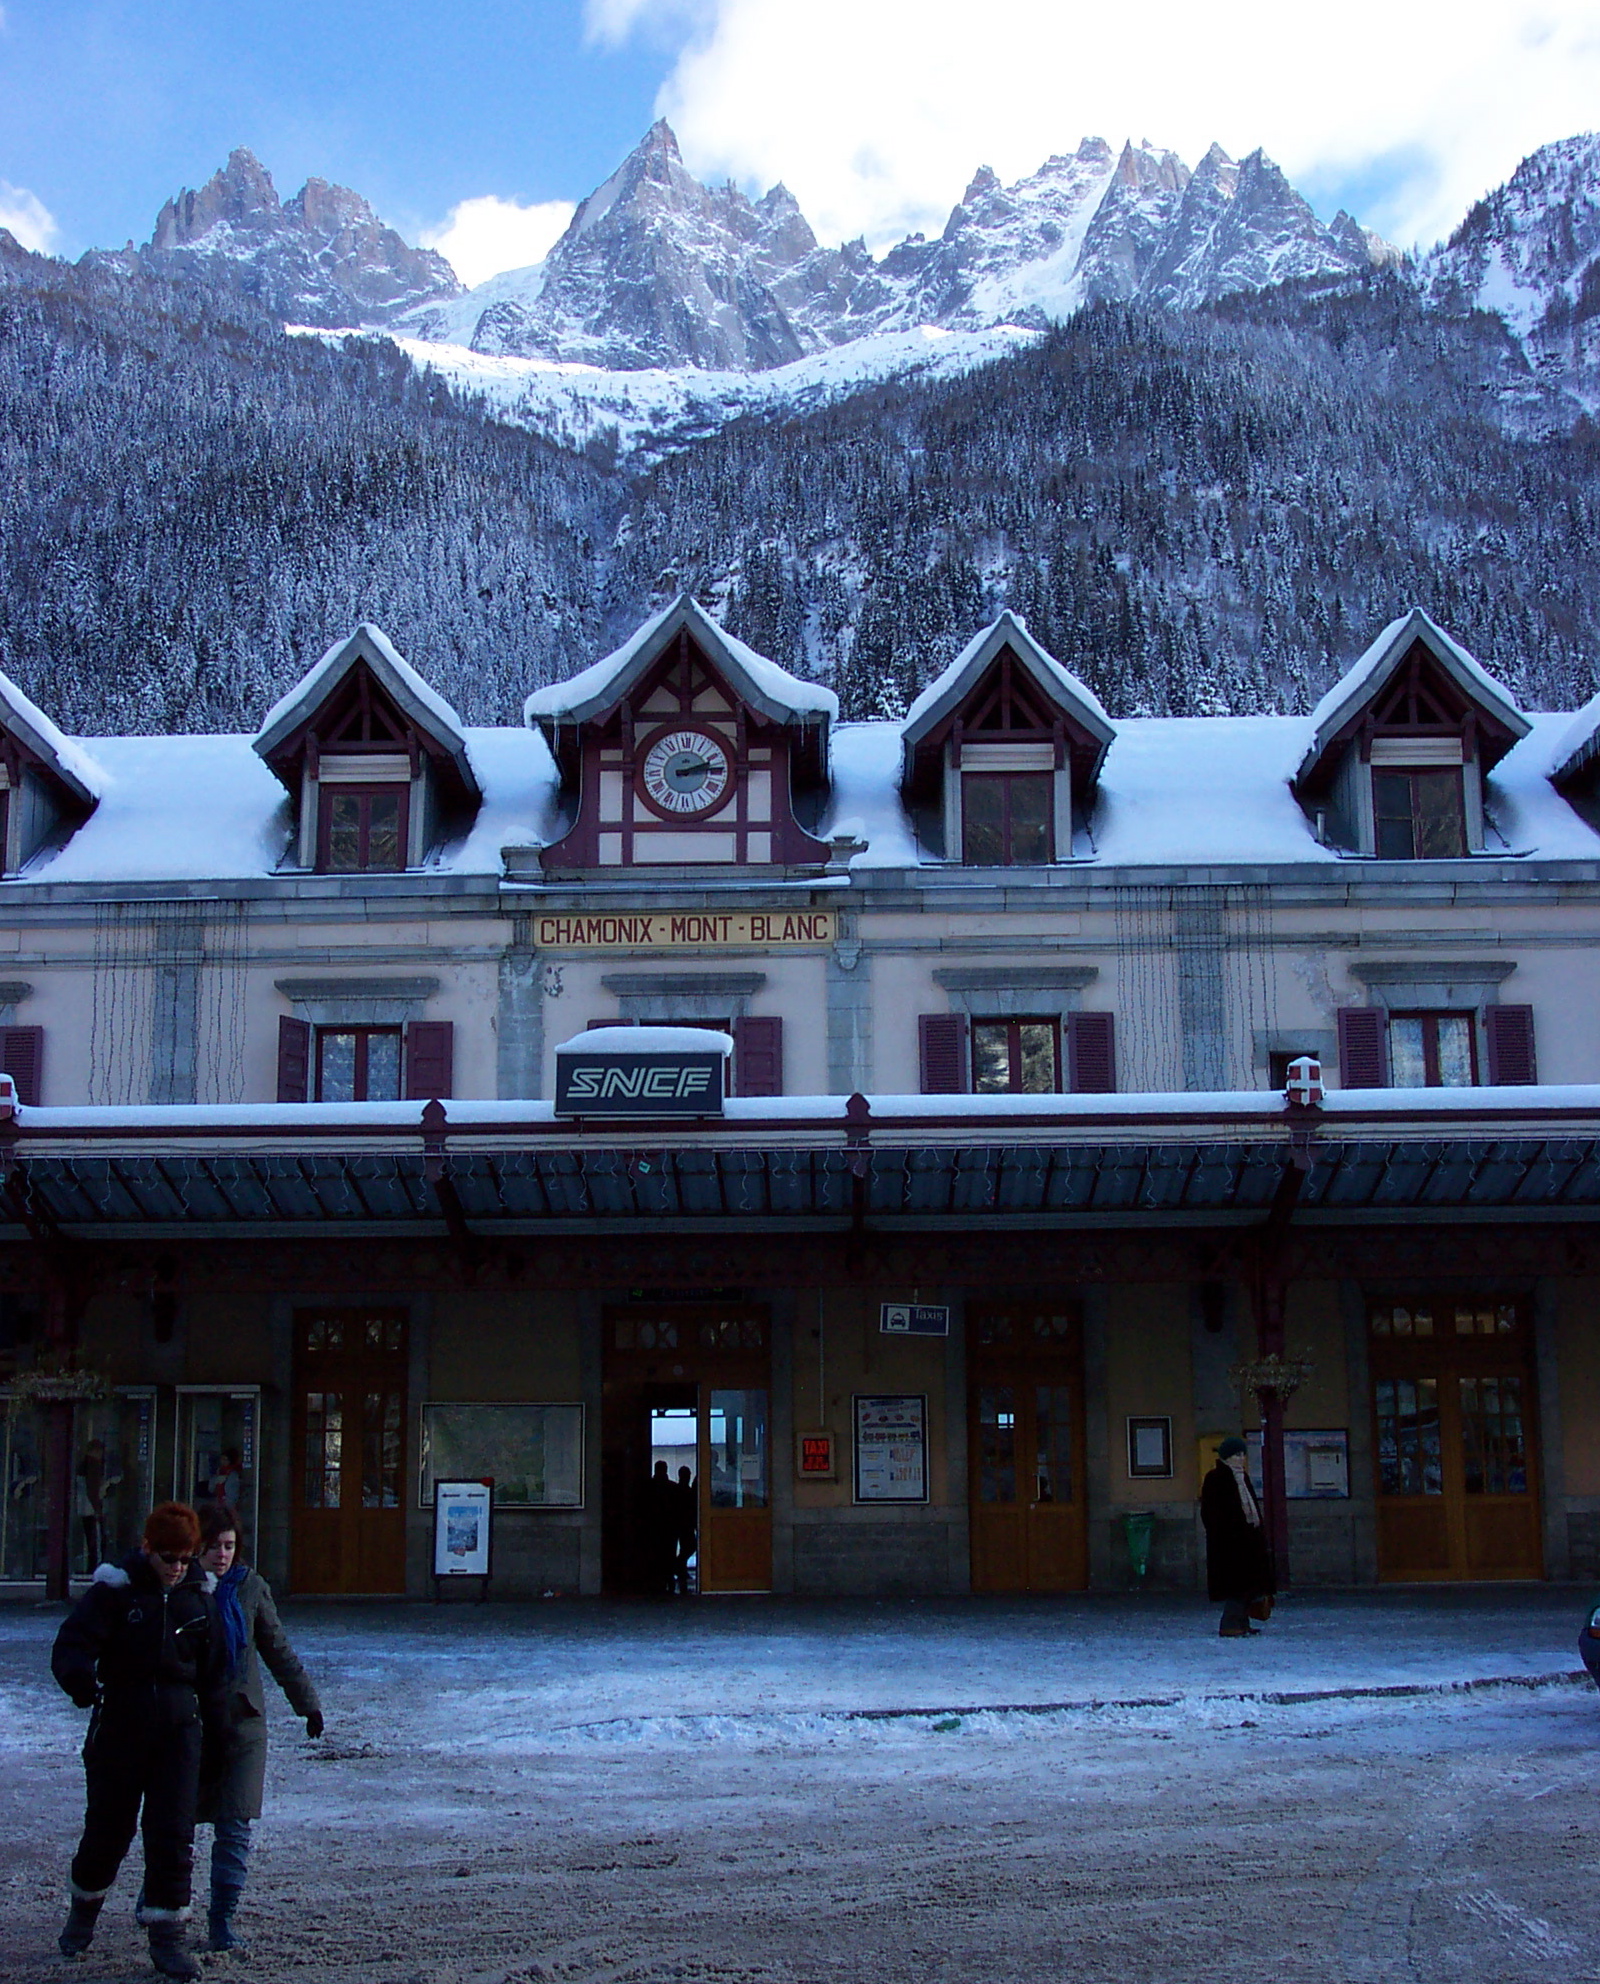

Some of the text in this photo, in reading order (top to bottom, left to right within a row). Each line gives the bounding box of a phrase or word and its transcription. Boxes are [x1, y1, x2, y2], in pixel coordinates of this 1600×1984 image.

[540, 917, 653, 944] CHAMONIX
[670, 916, 733, 943] MONT
[750, 914, 828, 941] BLANC
[566, 1067, 713, 1098] SNCF
[913, 1307, 945, 1321] Taxis
[803, 1440, 829, 1456] TAXI
